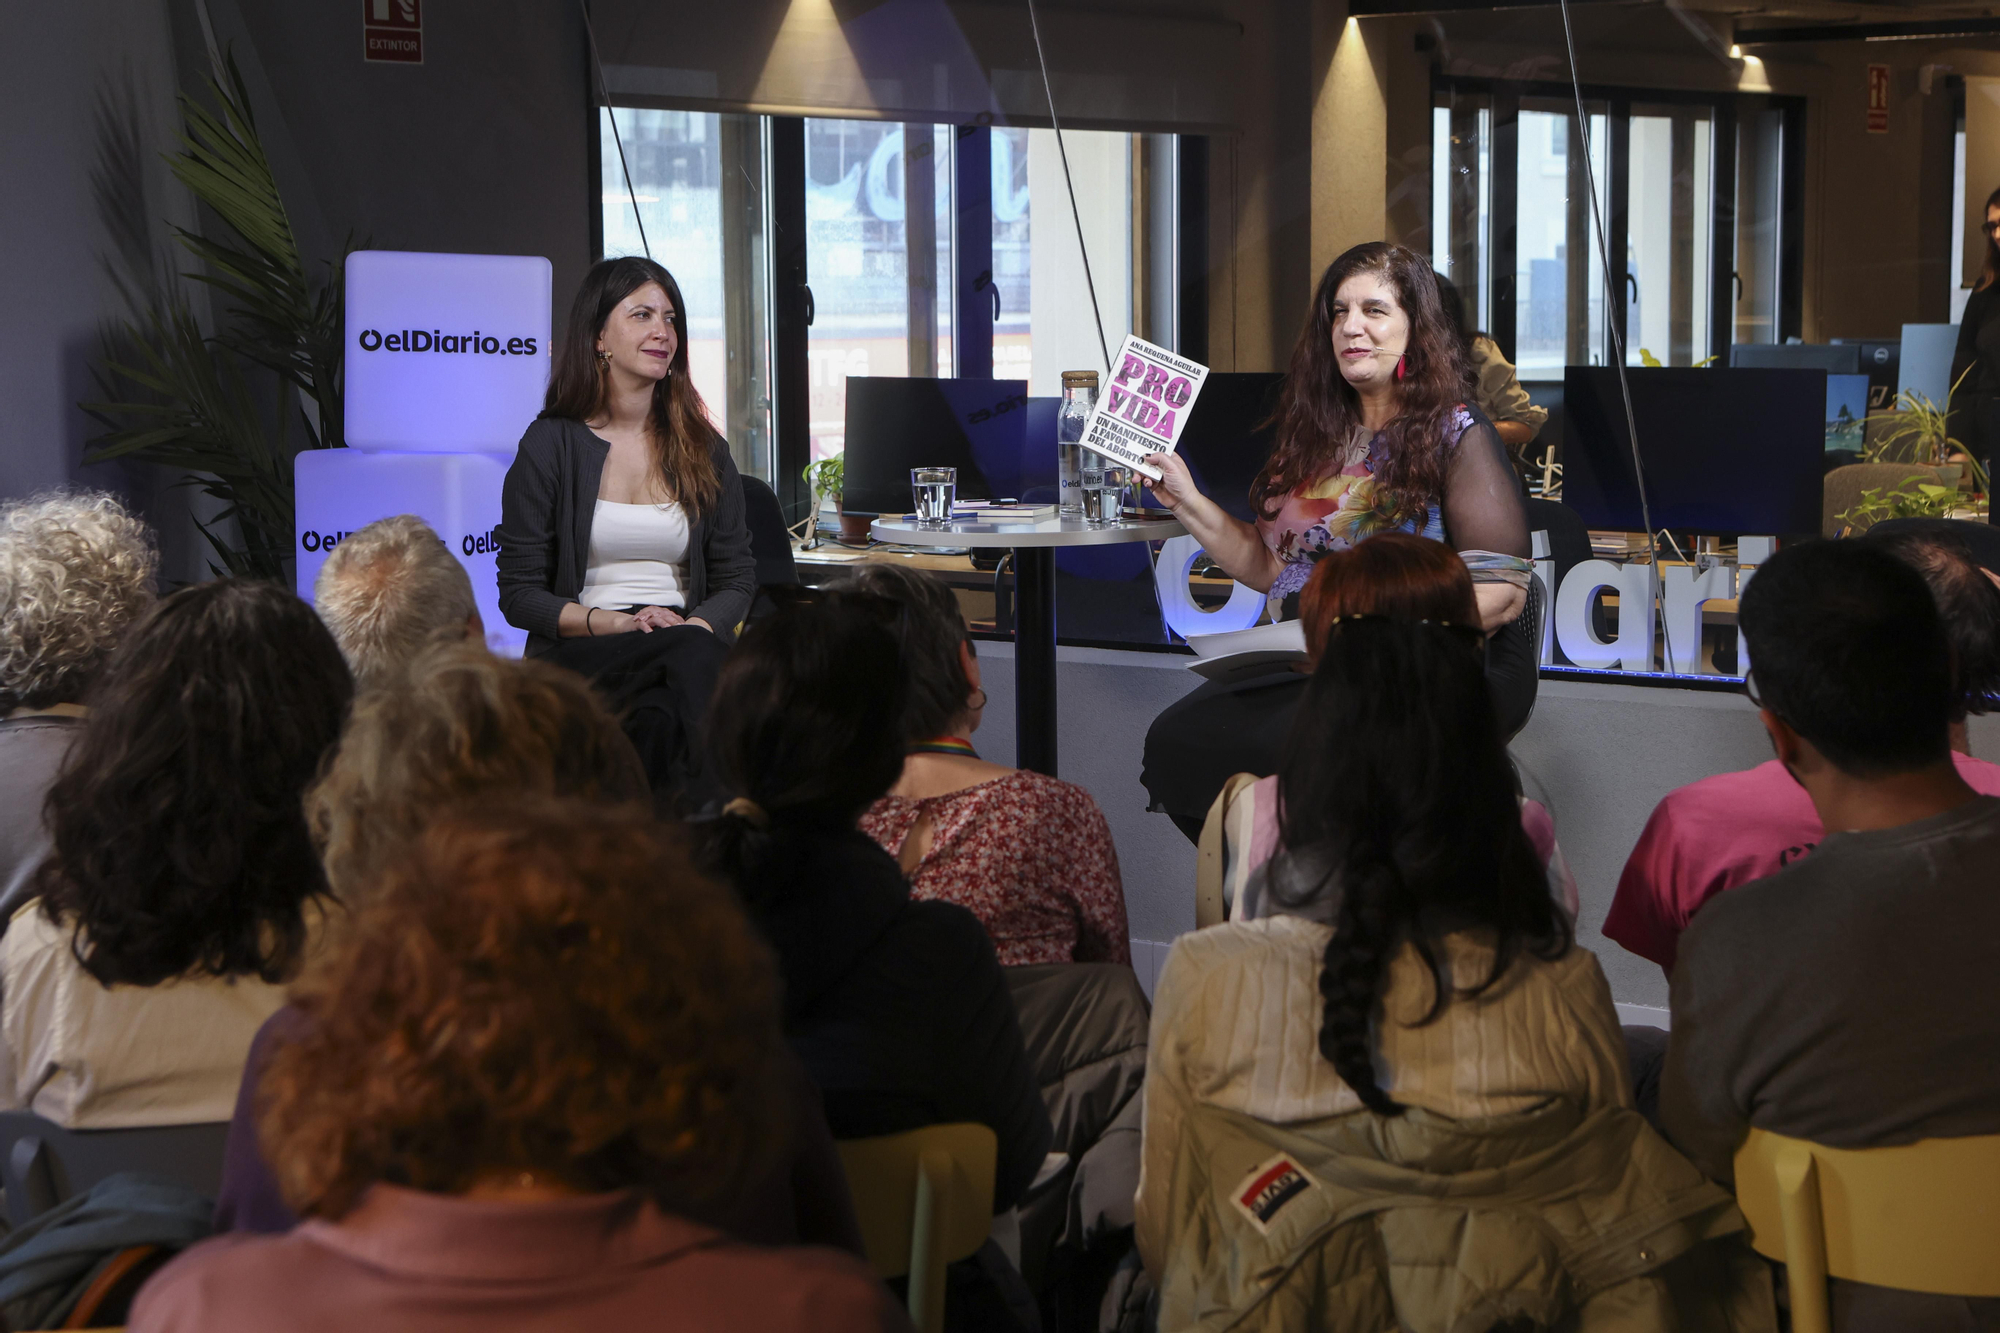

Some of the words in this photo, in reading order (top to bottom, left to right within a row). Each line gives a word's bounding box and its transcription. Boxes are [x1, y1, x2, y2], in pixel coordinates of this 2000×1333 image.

[369, 38, 418, 52] EXTINTOR
[384, 329, 538, 356] elDiario.es
[1130, 341, 1143, 351] ANA
[1143, 346, 1173, 364] REQUENA
[1173, 360, 1201, 376] AGUILAR
[1114, 353, 1192, 409] PRO
[1107, 384, 1176, 440] VIDA
[1087, 434, 1106, 448] DEL
[1106, 442, 1144, 465] ABORTO
[1091, 425, 1098, 434] A
[1099, 428, 1128, 448] FAVOR
[1096, 416, 1110, 428] UN
[1110, 422, 1167, 454] MANIFIESTO
